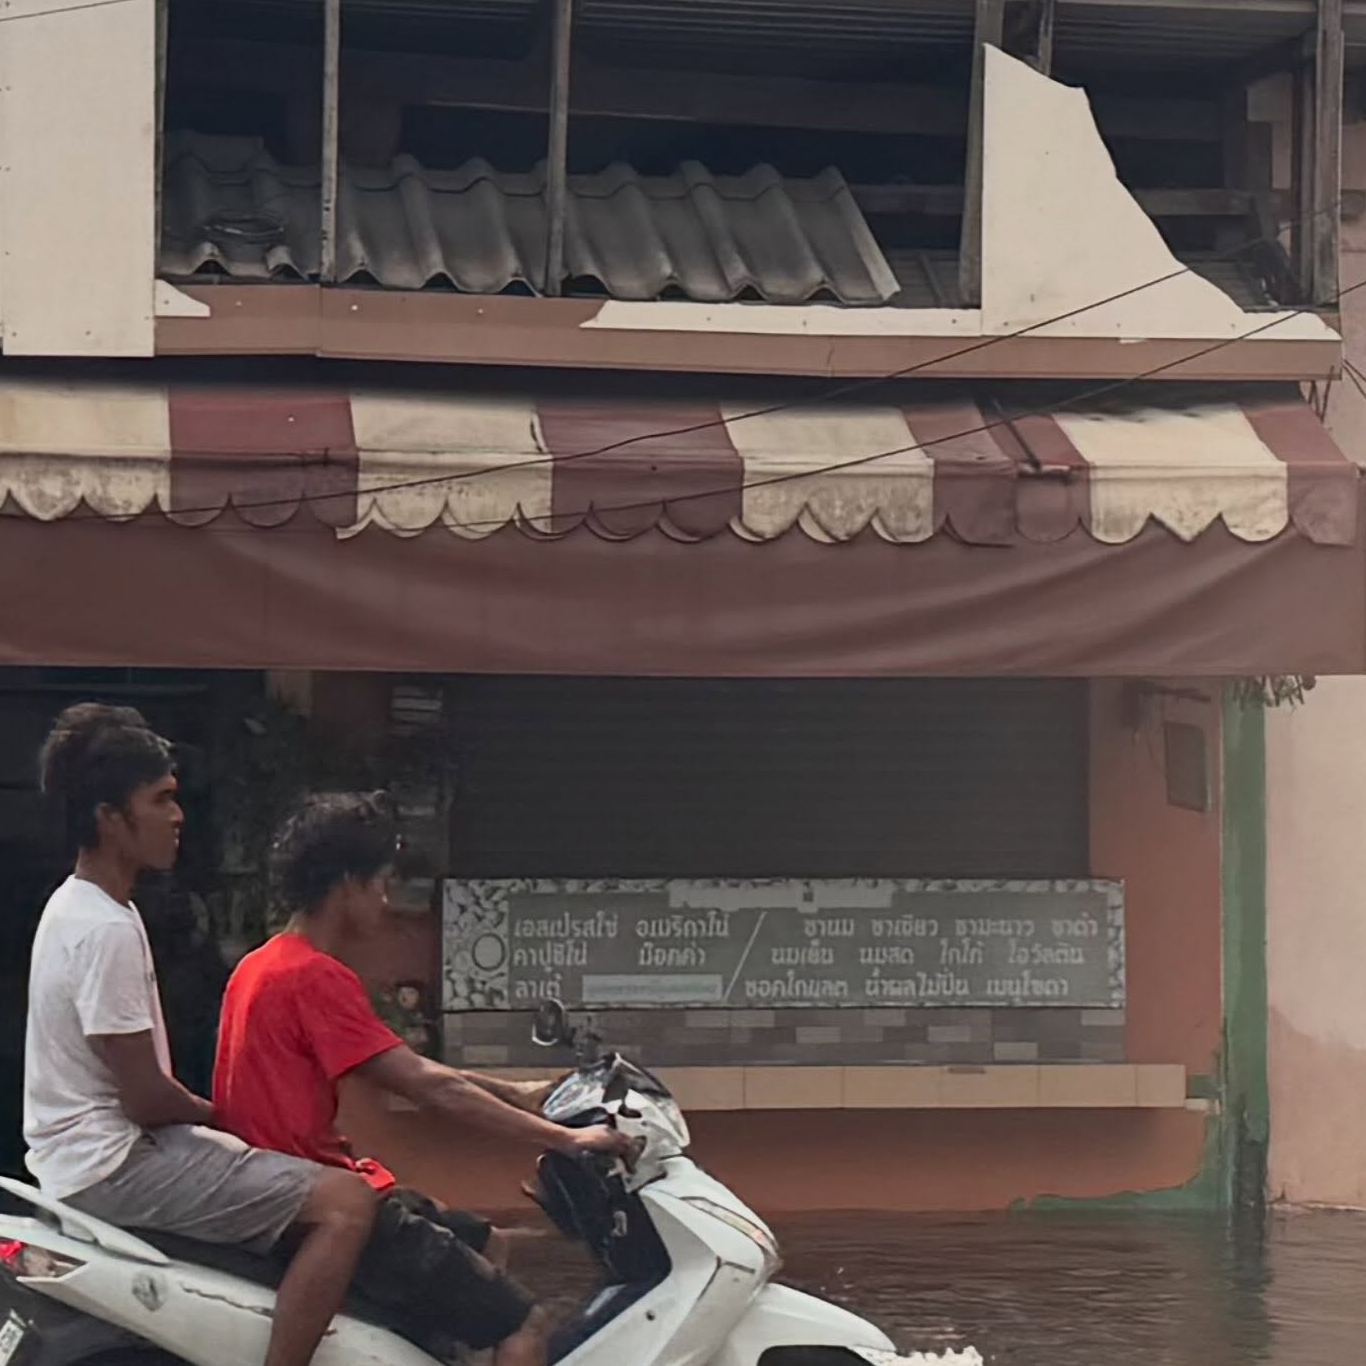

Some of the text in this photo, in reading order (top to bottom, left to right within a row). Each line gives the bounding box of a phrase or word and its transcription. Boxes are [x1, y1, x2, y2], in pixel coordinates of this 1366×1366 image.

[803, 912, 1099, 938] ชานม ชาเขียว ชามะนาว ชาดำ
[770, 938, 835, 965] นมเย็น
[858, 946, 915, 965] นมสด
[939, 937, 986, 965] โกโก้
[514, 972, 562, 999] ลาเต้
